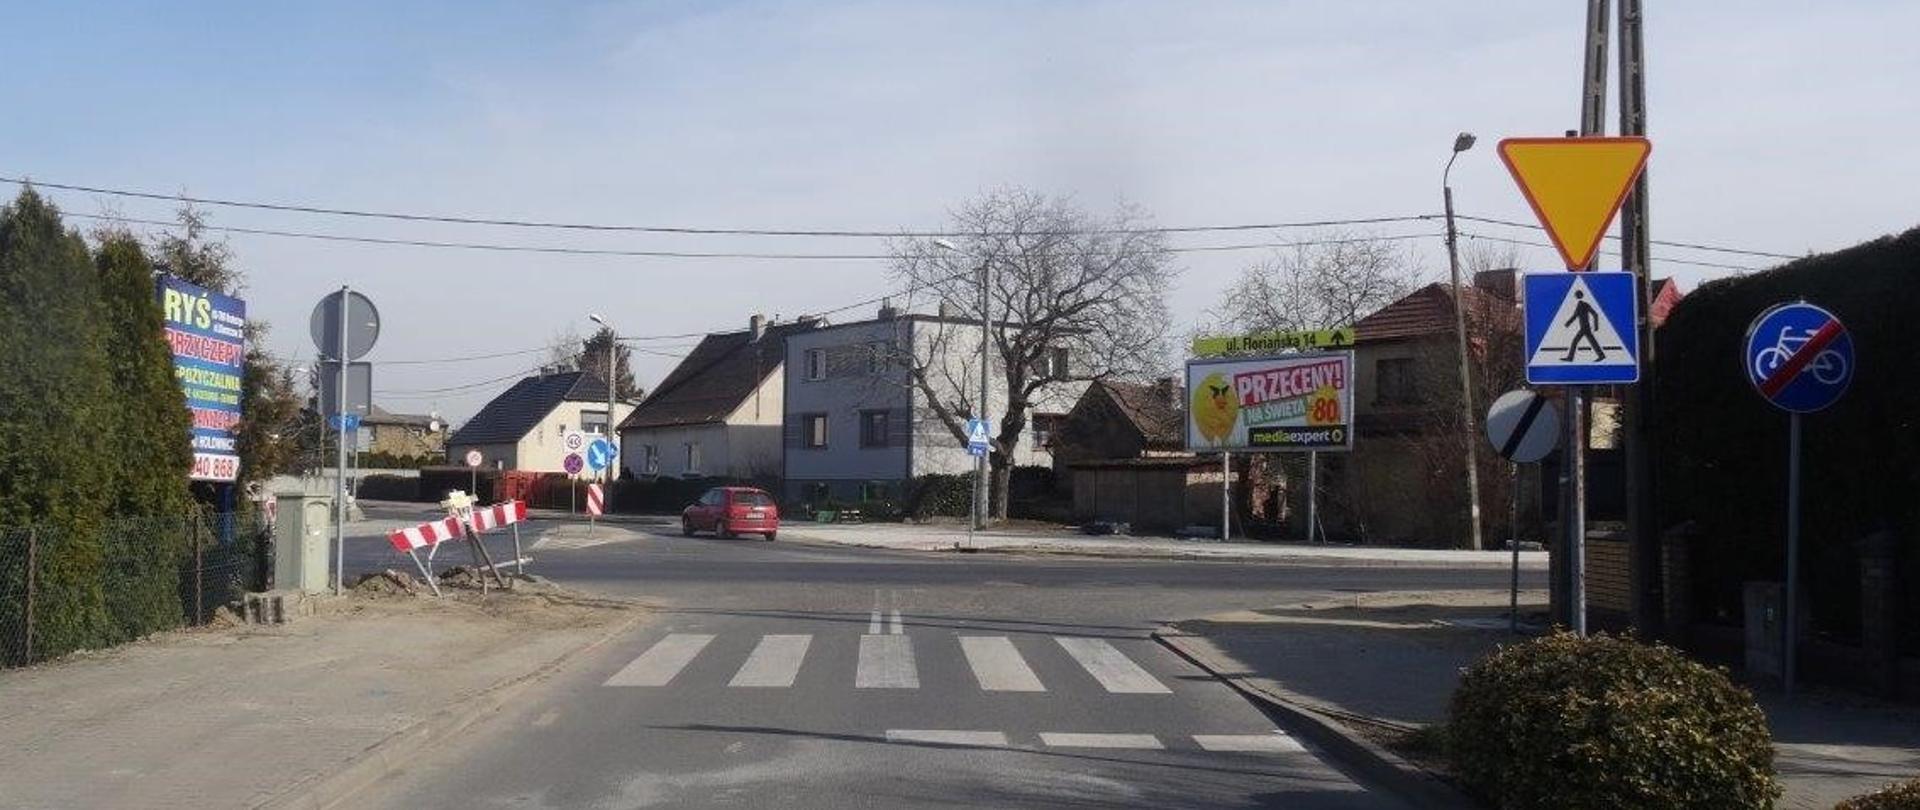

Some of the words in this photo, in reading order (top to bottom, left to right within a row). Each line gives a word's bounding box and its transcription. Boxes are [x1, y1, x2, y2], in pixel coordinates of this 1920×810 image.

[164, 287, 211, 330] RYŚ
[1226, 337, 1240, 351] ul.
[1243, 333, 1300, 351] Floriańska
[1303, 332, 1316, 346] 14
[1239, 364, 1342, 406] PRZECENY!
[1249, 406, 1263, 424] NA
[1253, 431, 1330, 444] mediaexpert
